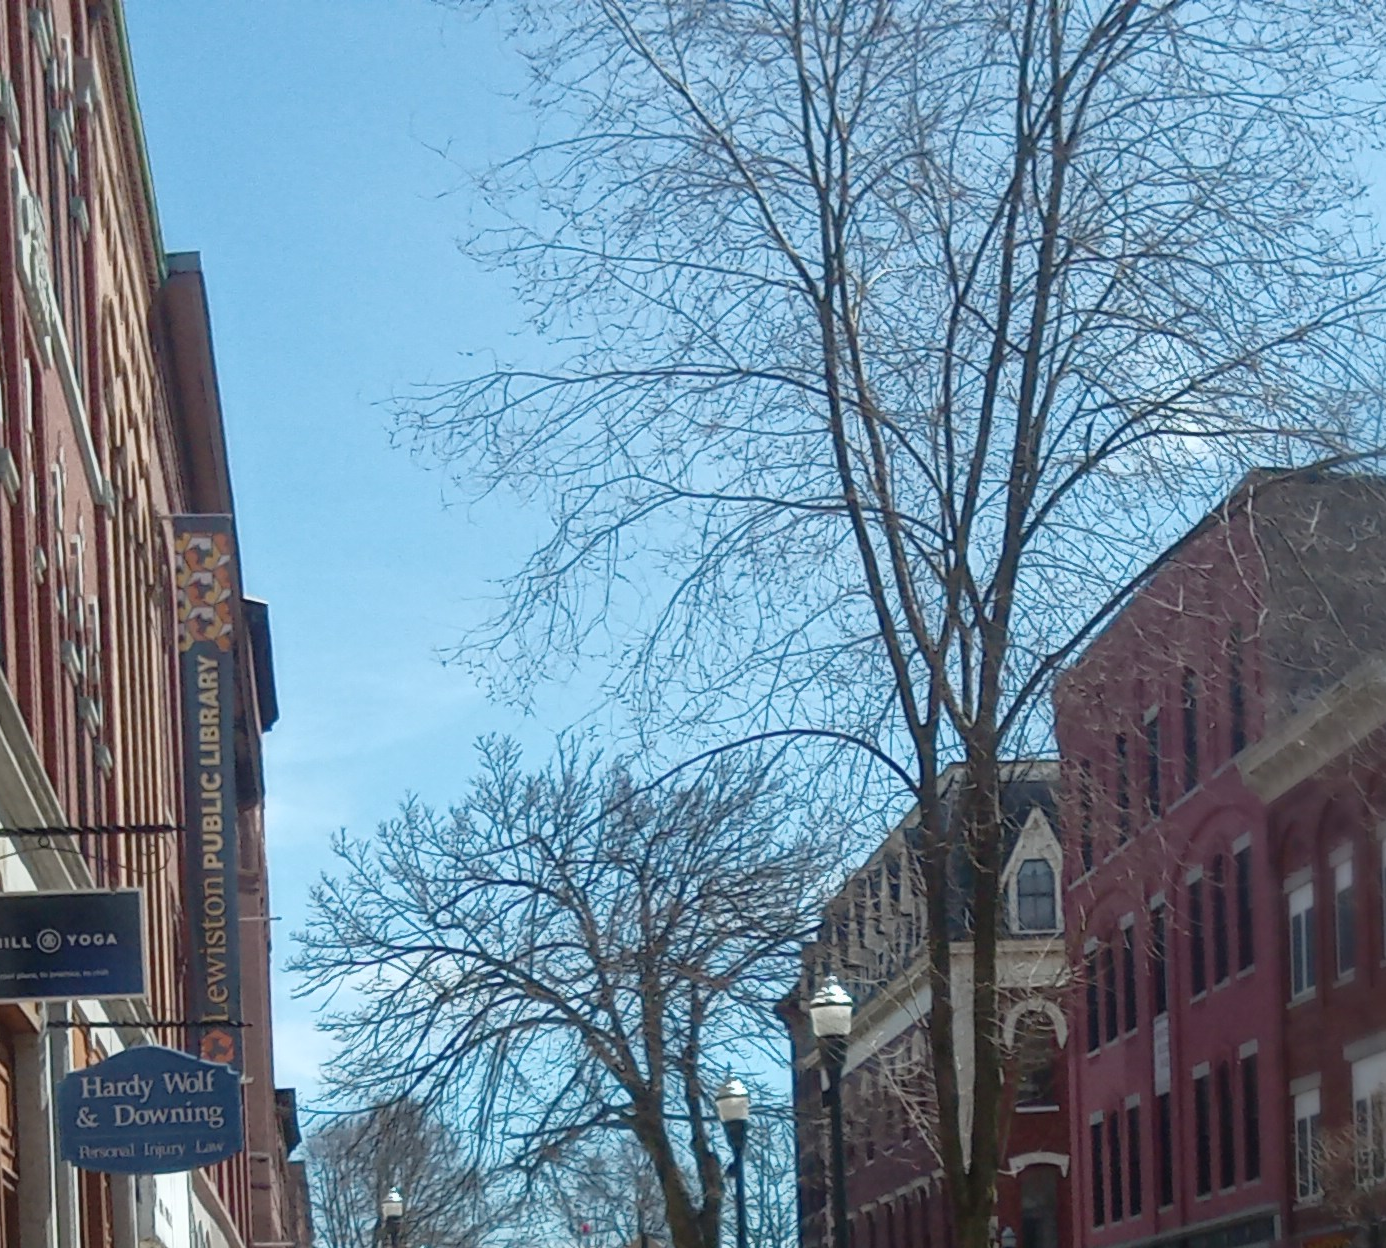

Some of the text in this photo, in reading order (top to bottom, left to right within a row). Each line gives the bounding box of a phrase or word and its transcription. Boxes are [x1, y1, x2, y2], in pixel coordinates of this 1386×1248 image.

[198, 654, 229, 1024] Lewiston PUBLIC LIBRARY
[67, 934, 117, 946] YOGA
[81, 1069, 216, 1103] Hardy Wolf
[76, 1101, 225, 1129] & Downing
[79, 1139, 225, 1160] Personal Injury Law
